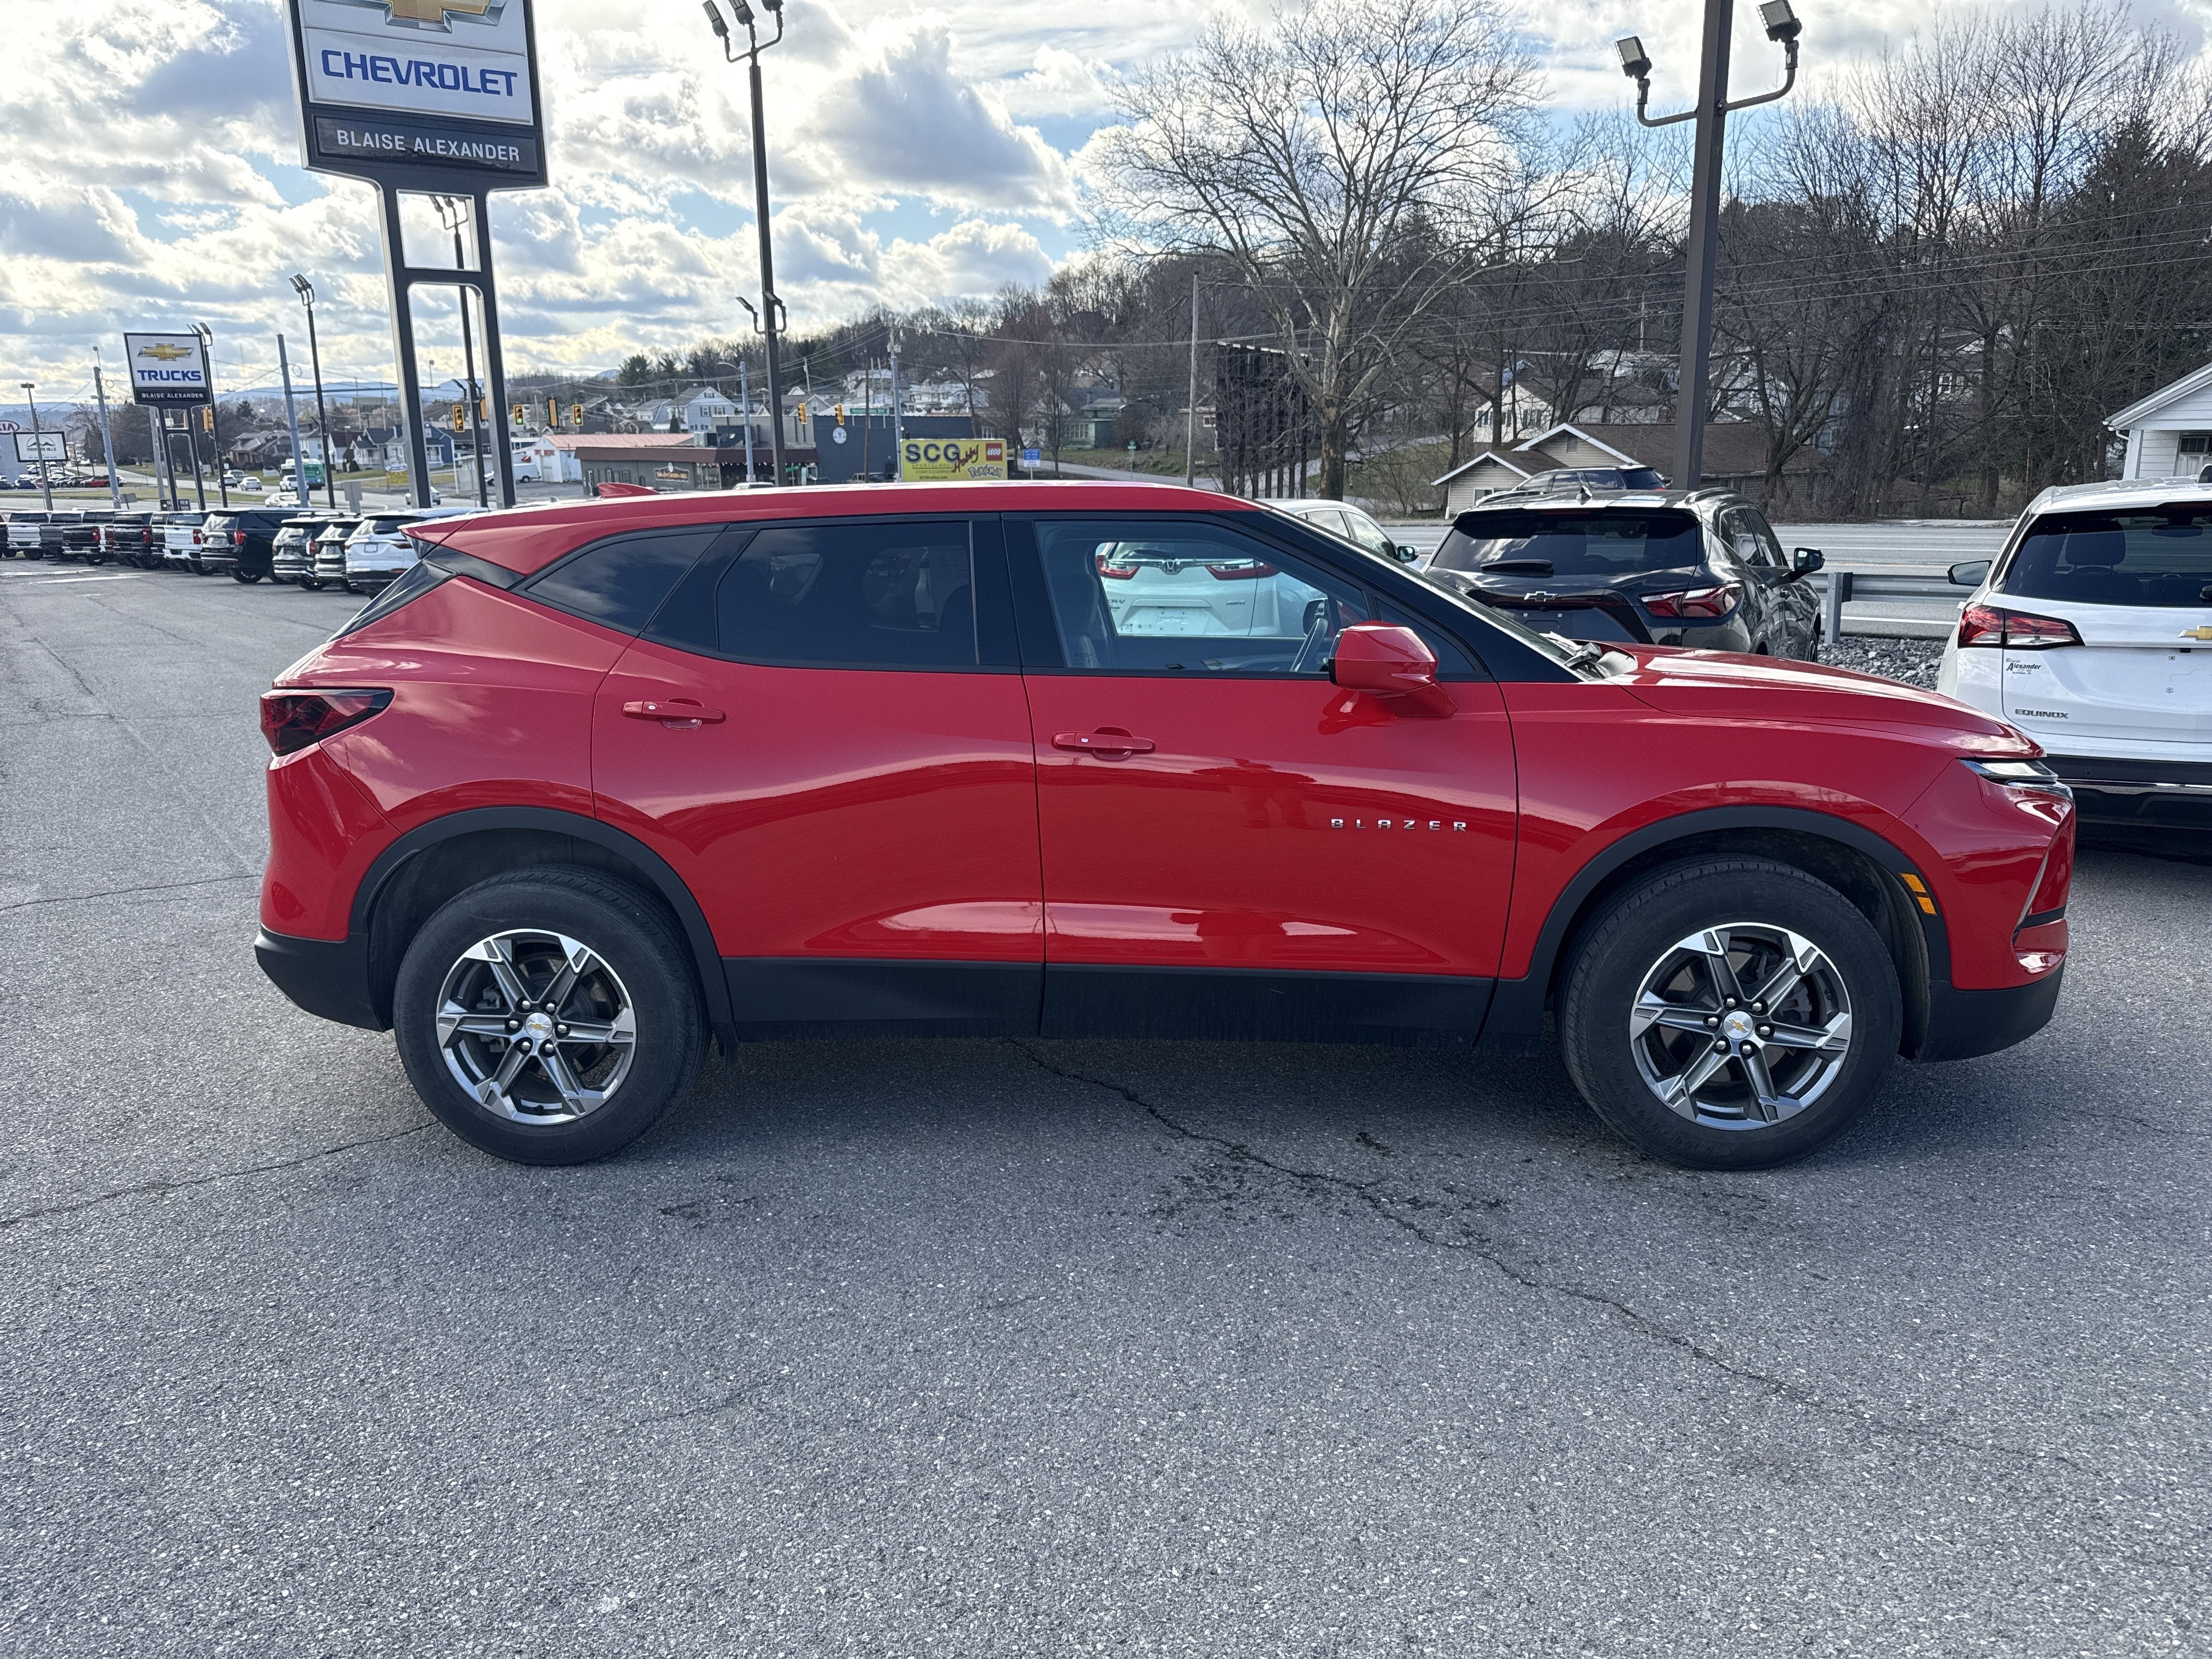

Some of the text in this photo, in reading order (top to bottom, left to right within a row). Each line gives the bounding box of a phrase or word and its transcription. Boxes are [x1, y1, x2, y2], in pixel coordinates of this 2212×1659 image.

[321, 49, 518, 97] CHEVROLET
[336, 129, 520, 162] BLAISE ALEXANDER
[137, 370, 202, 381] TRUCKS
[905, 443, 960, 464] SCG
[951, 444, 979, 473] Hobby
[987, 447, 1002, 456] LEGO
[2006, 662, 2041, 671] Alexander
[2015, 709, 2069, 719] EQUINOX
[1330, 818, 1467, 833] BLAZER
